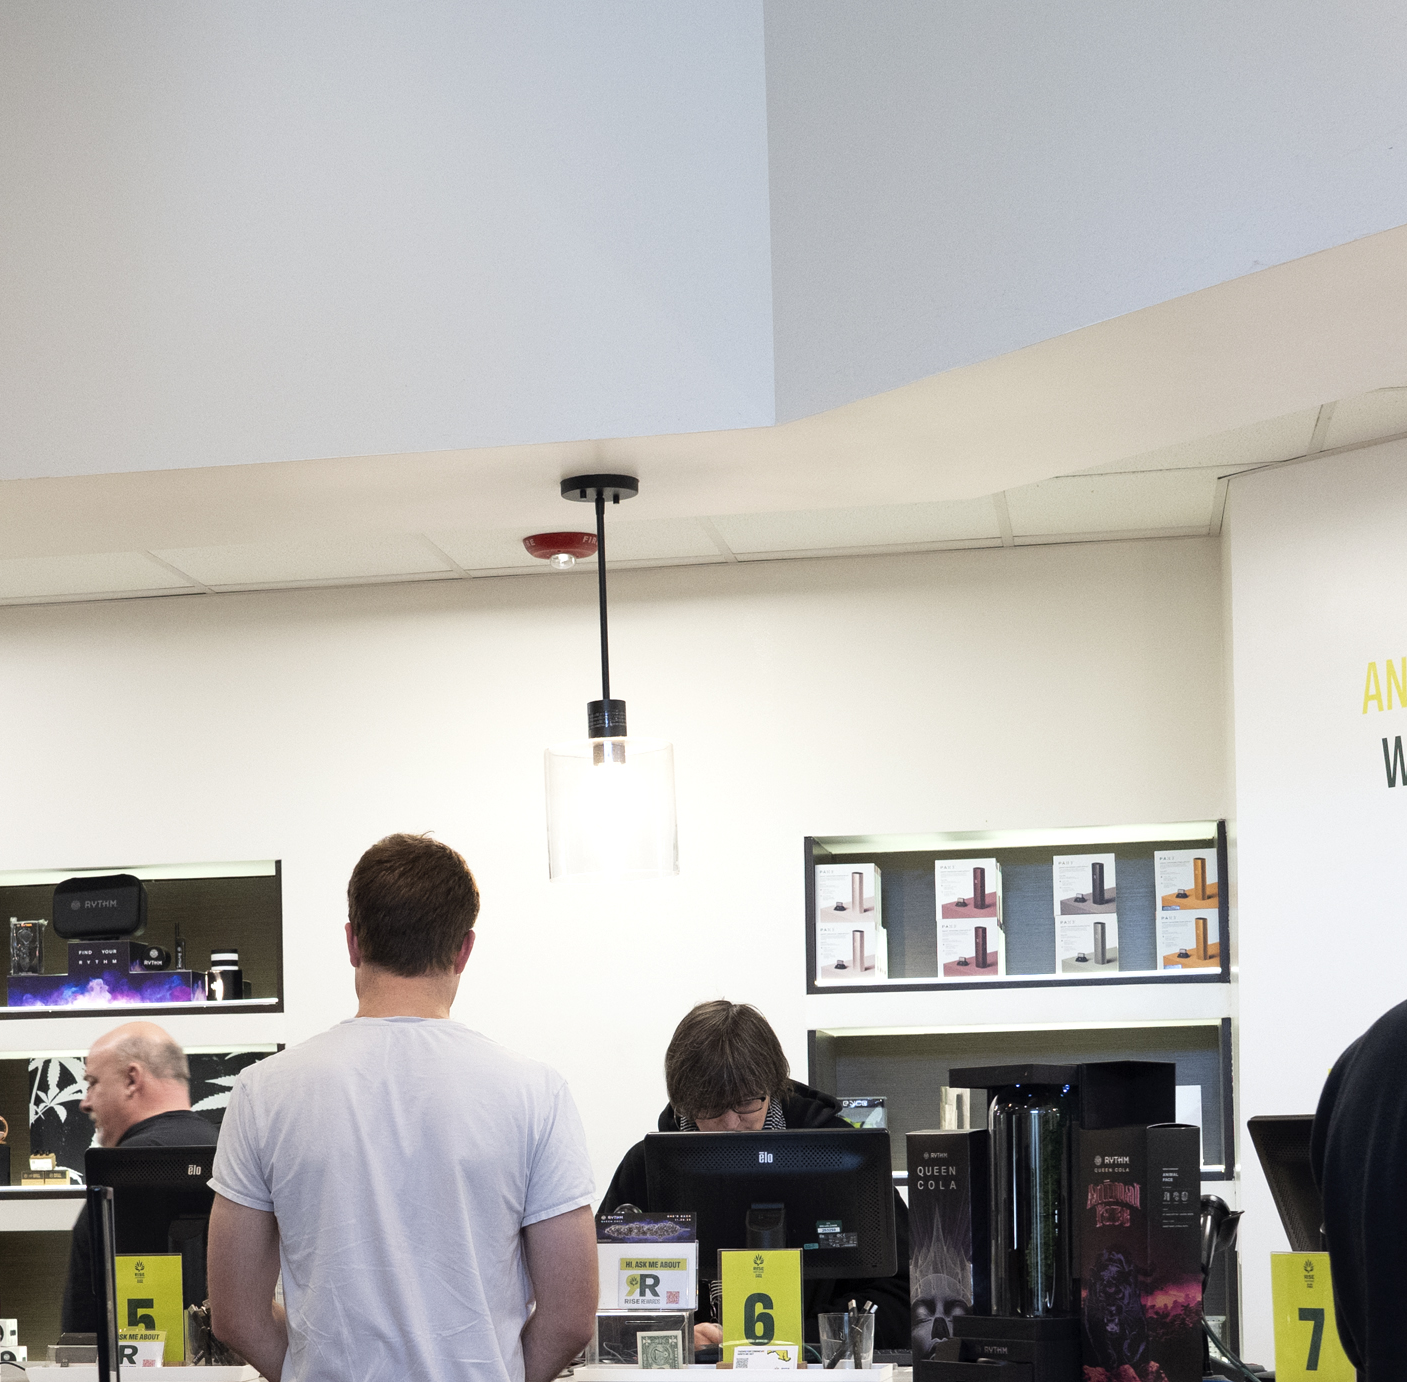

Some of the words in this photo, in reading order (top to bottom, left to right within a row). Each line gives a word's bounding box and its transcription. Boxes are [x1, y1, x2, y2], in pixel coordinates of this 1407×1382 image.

[582, 535, 598, 545] FIR
[85, 899, 117, 909] RYTHM
[1104, 1156, 1130, 1164] RYTHM
[917, 1166, 956, 1177] QUEEN
[917, 1180, 957, 1190] COLA
[635, 1261, 648, 1269] ASK
[648, 1261, 658, 1269] ME
[659, 1261, 681, 1269] ABOUT
[127, 1298, 156, 1331] 5
[744, 1292, 775, 1346] 6
[118, 1333, 128, 1341] SK
[128, 1333, 138, 1341] ME
[138, 1333, 160, 1341] ABOUT
[1298, 1307, 1325, 1371] 7
